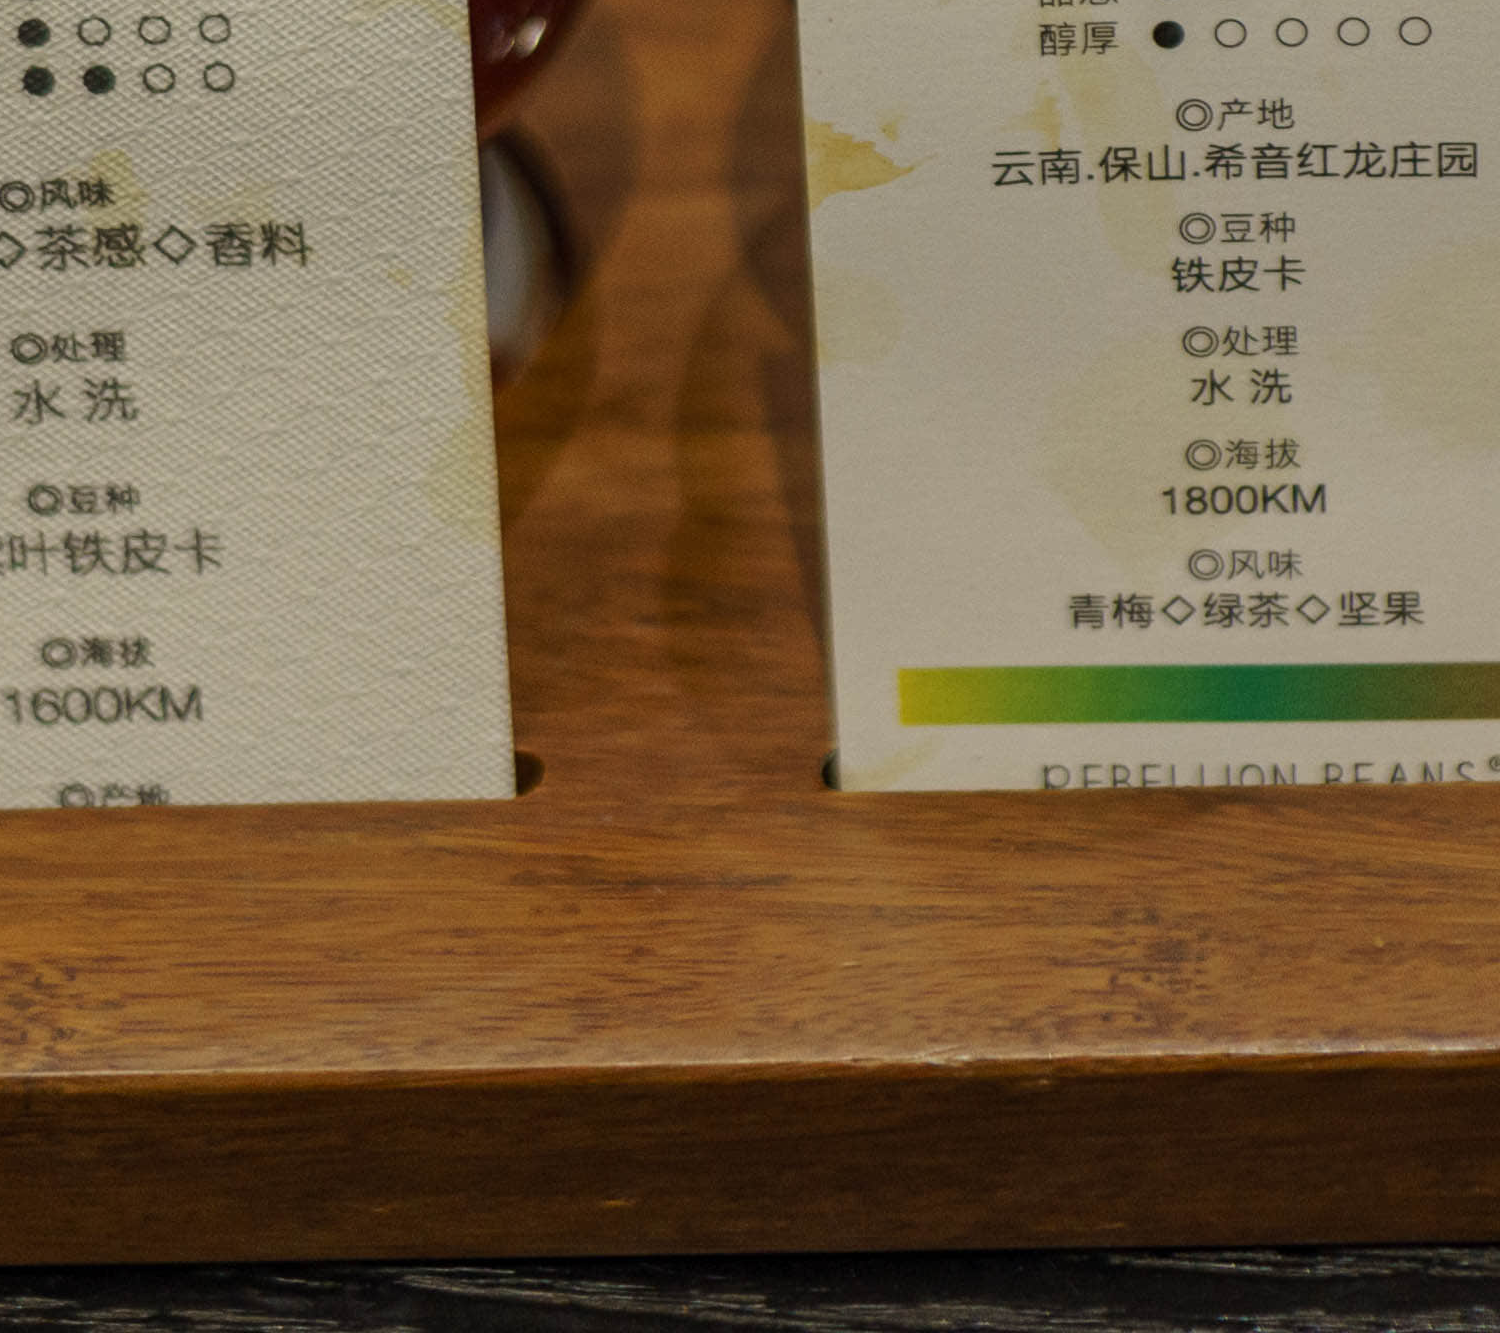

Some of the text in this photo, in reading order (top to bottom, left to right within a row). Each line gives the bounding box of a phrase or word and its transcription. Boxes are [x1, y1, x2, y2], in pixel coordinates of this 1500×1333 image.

[1038, 21, 1116, 57] 醇厚
[1216, 97, 1296, 131] 产地
[39, 177, 115, 211] 风味
[1220, 211, 1296, 244] 豆种
[35, 222, 147, 272] 茶感
[205, 220, 312, 268] 香料
[1170, 255, 1305, 294] 铁皮卡
[49, 330, 125, 363] 处理
[1221, 325, 1297, 357] 处理
[12, 377, 139, 426] 水洗
[1190, 368, 1293, 407] 水洗
[1225, 438, 1299, 471] 海拔
[68, 484, 140, 515] 豆种
[1161, 483, 1326, 516] 1800KM
[1227, 549, 1302, 580] 风味
[1068, 591, 1422, 630] 青梅 绿茶 坚果
[79, 636, 149, 668] 海拔
[4, 685, 203, 726] 1600KM
